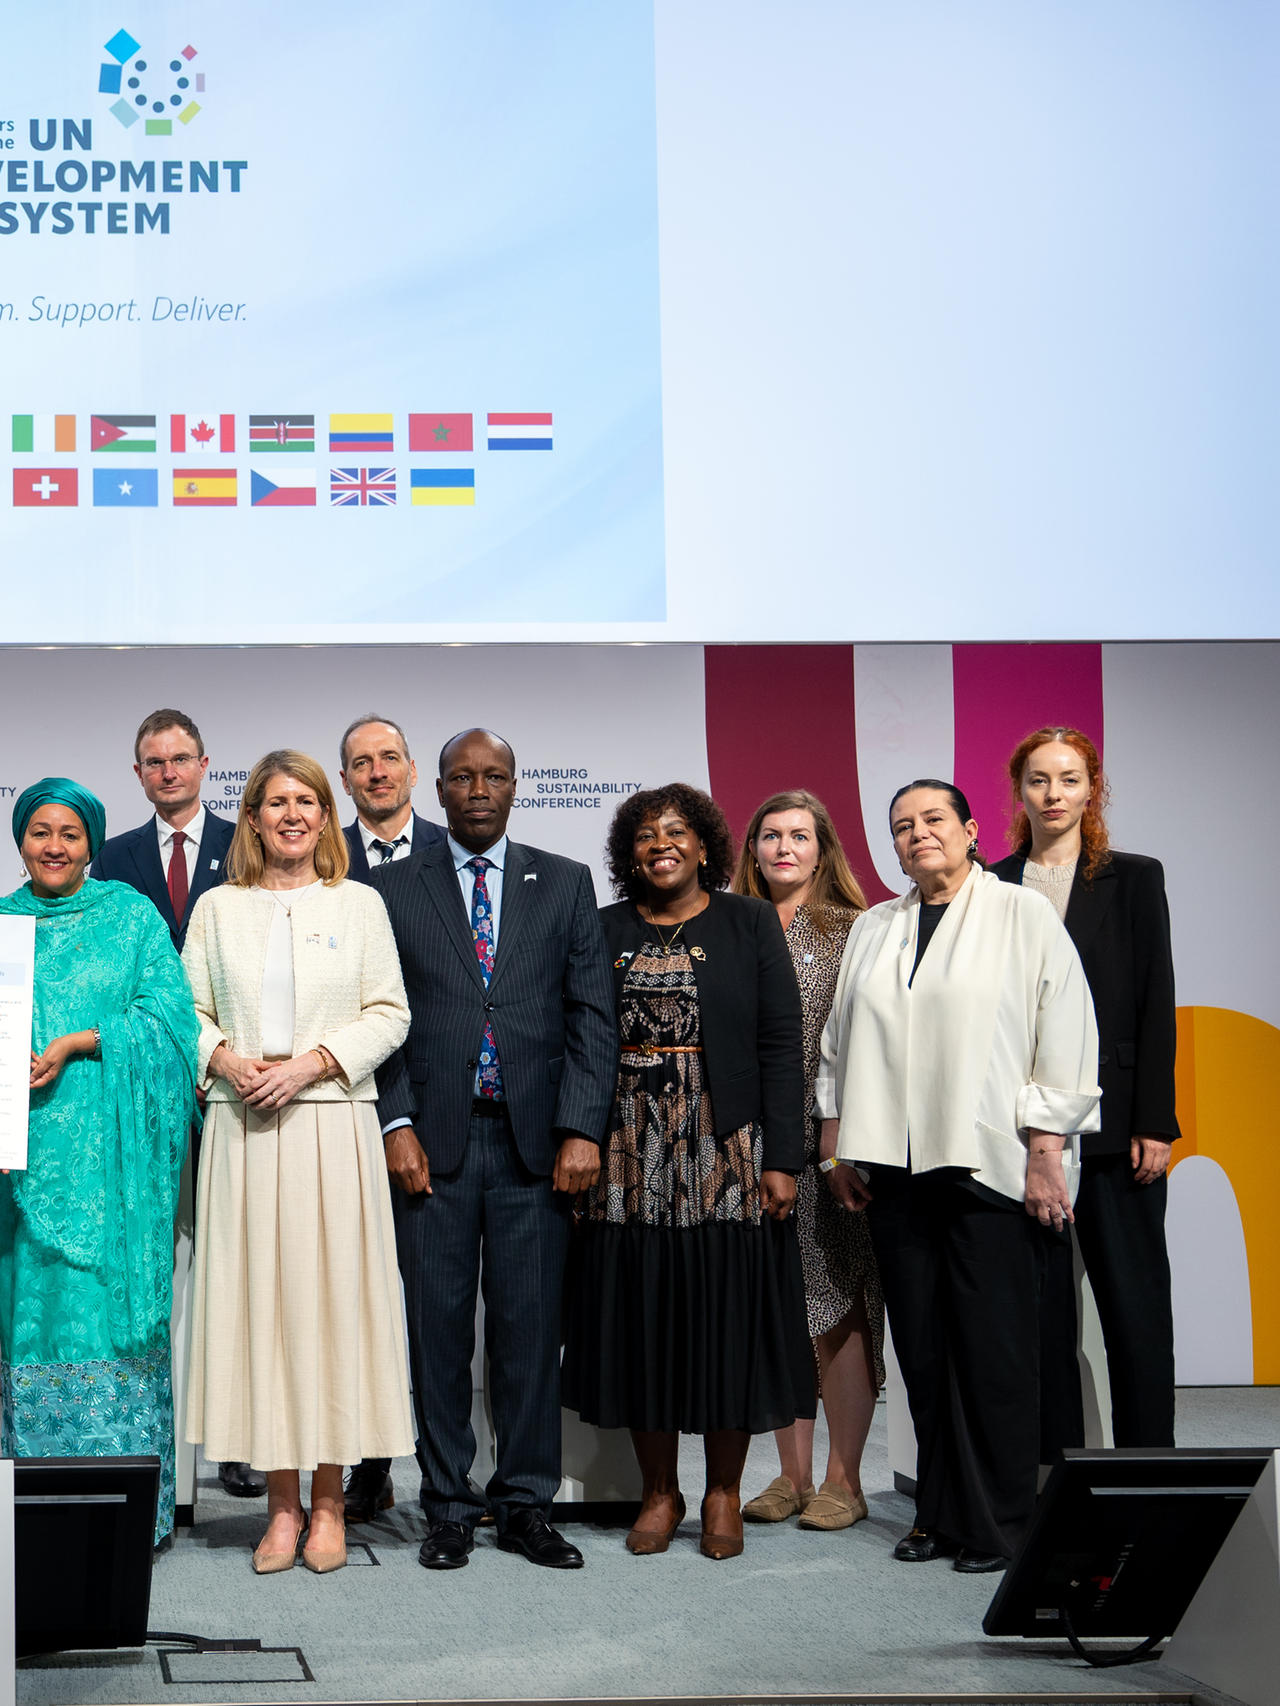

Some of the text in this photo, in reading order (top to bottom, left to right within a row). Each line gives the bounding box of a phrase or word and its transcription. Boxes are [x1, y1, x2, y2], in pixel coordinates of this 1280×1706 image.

[29, 118, 92, 151] UN
[28, 295, 141, 328] Support.
[152, 296, 247, 321] Deliver.
[209, 771, 250, 782] HAMB
[522, 768, 588, 779] HAMBURG
[536, 783, 642, 794] SUSTAINABILITY
[513, 797, 601, 808] CONFERENCE
